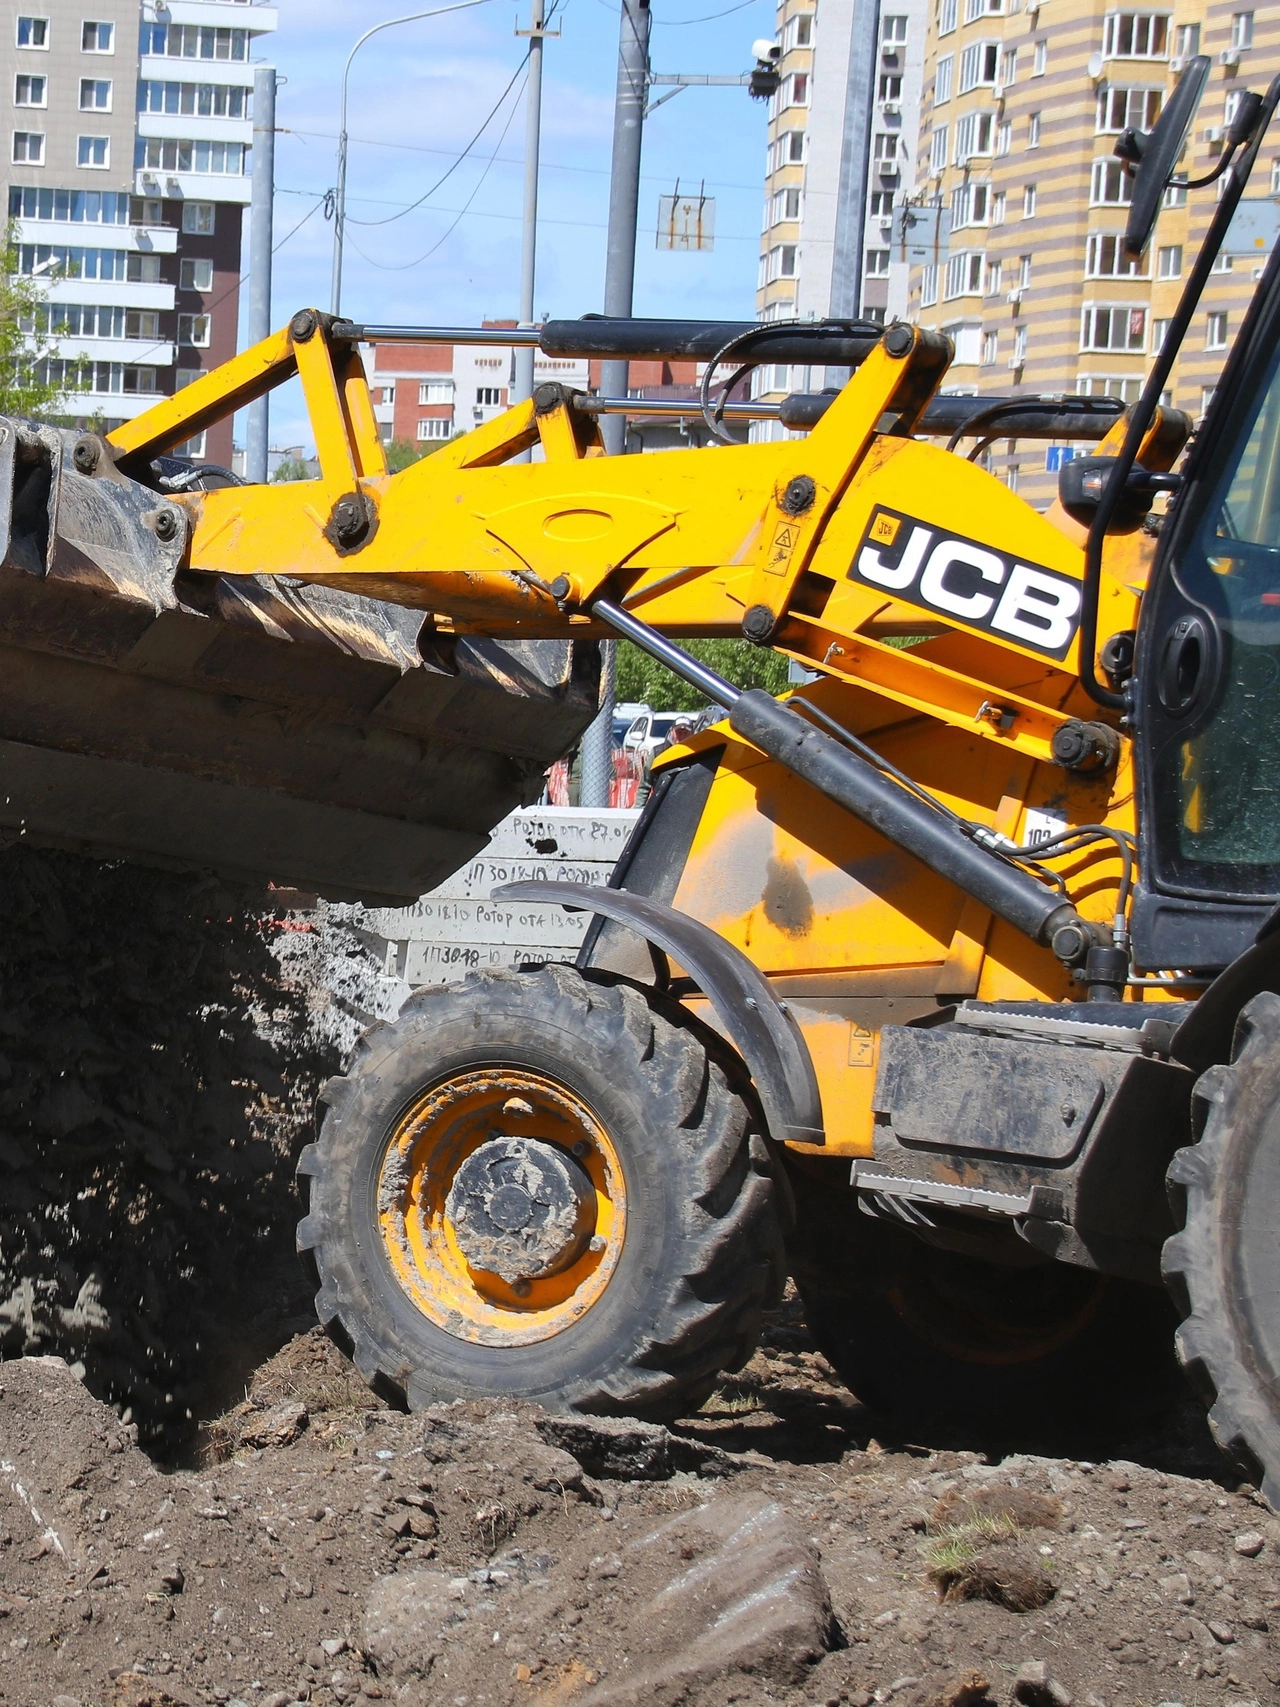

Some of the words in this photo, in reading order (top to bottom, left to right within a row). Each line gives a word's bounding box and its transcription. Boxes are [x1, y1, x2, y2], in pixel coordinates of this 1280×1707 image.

[878, 521, 892, 535] JCB
[858, 526, 1081, 649] JCB
[476, 905, 512, 928] РОТОР
[518, 913, 546, 927] ОТК
